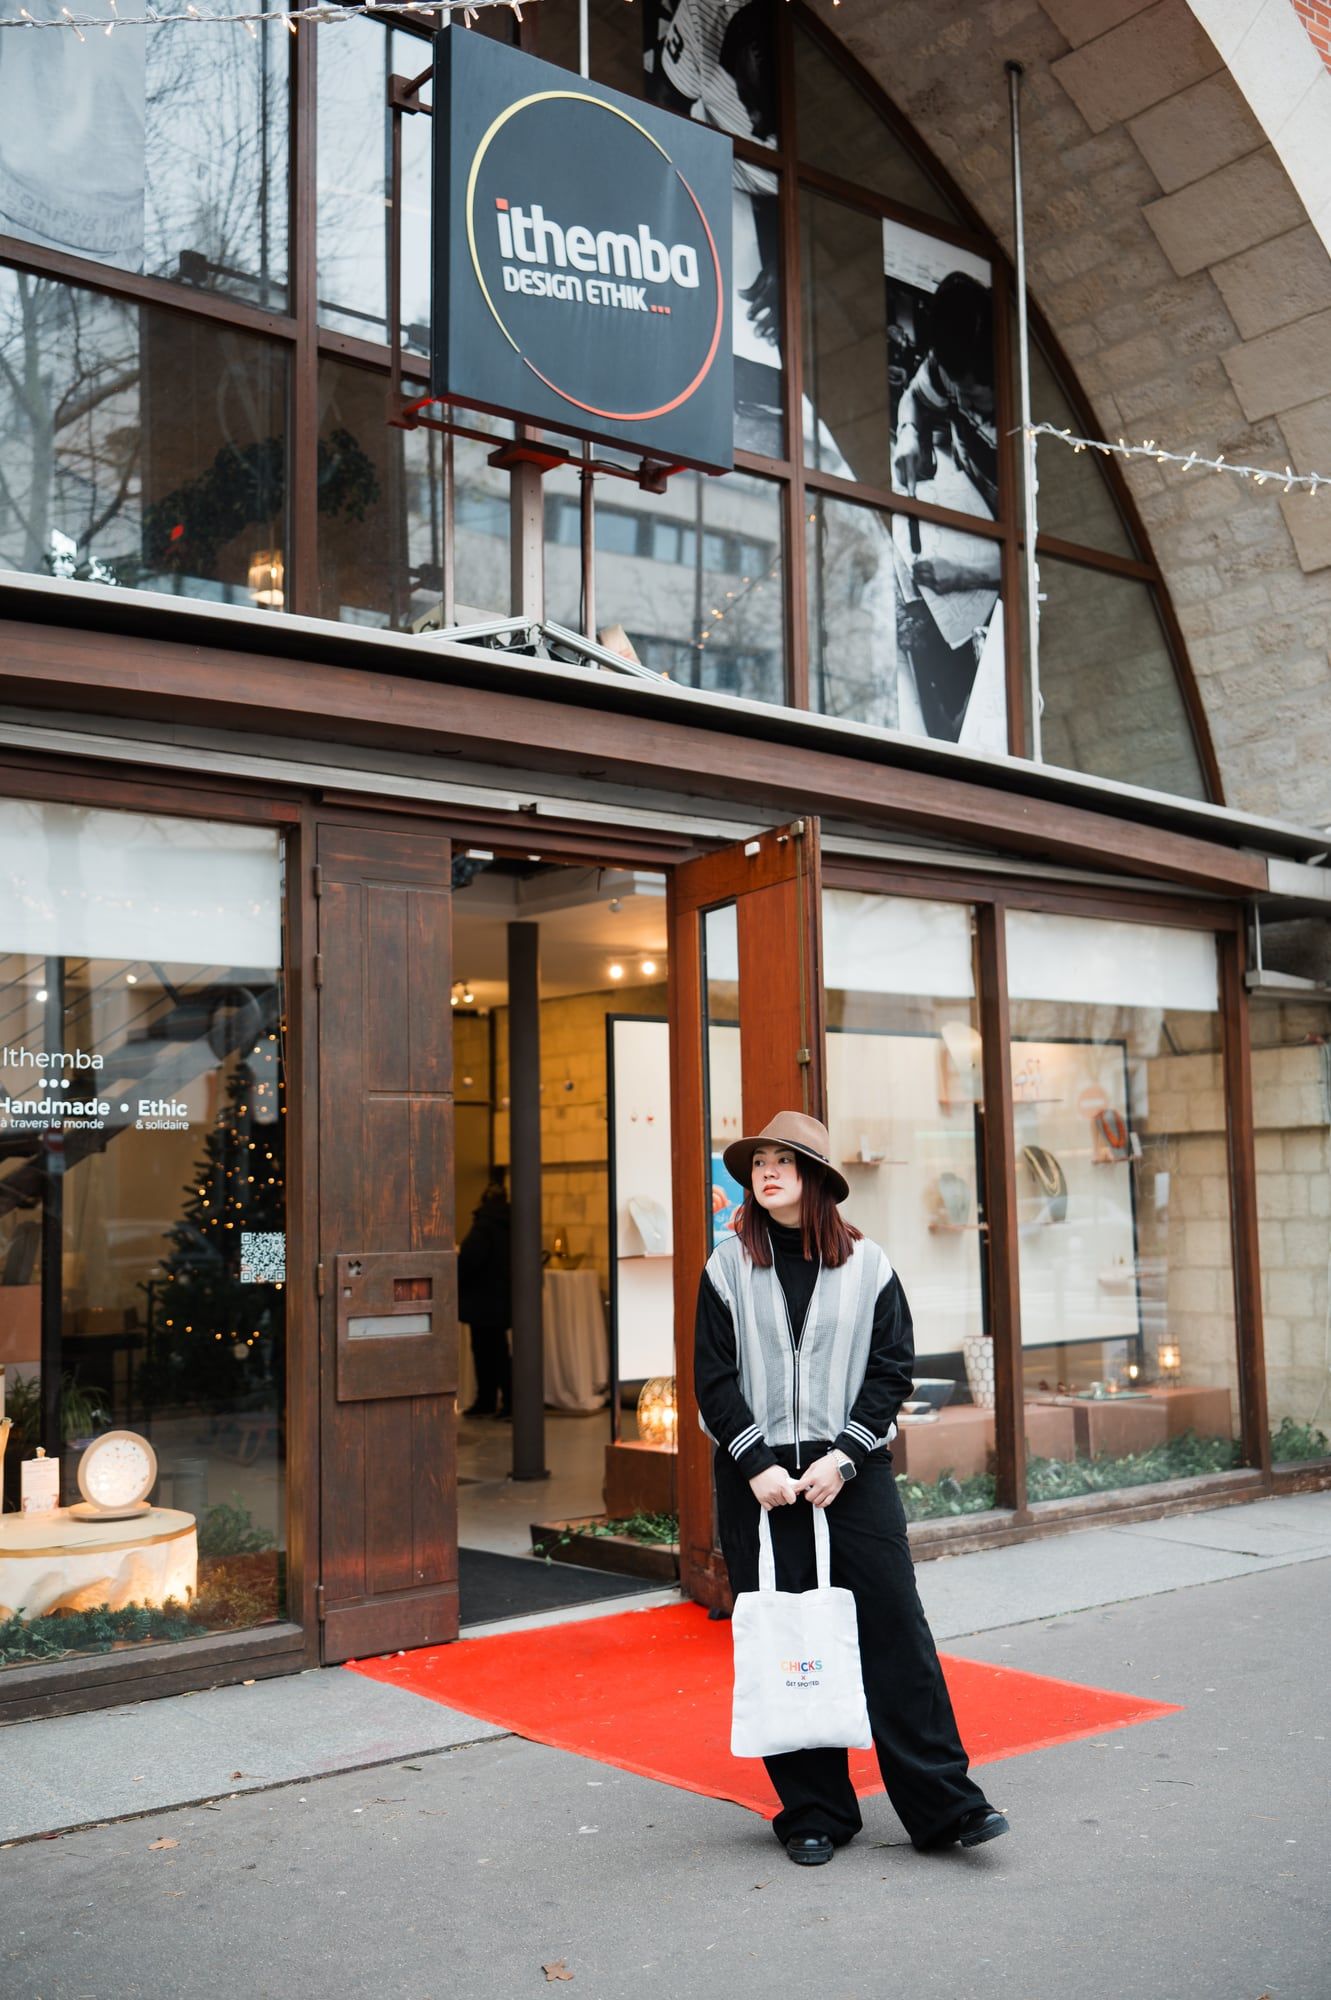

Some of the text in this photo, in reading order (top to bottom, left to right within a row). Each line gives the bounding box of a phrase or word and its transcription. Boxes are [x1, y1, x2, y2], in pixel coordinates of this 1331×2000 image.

[495, 198, 700, 288] ithemba
[502, 266, 583, 302] DESIGN
[3, 1046, 104, 1069] Ithemba
[138, 1099, 188, 1117] Ethic
[10, 1119, 49, 1128] travers
[51, 1118, 61, 1128] le
[64, 1119, 104, 1129] monde
[136, 1120, 189, 1130] & solidaire
[781, 1660, 823, 1672] CHICKS
